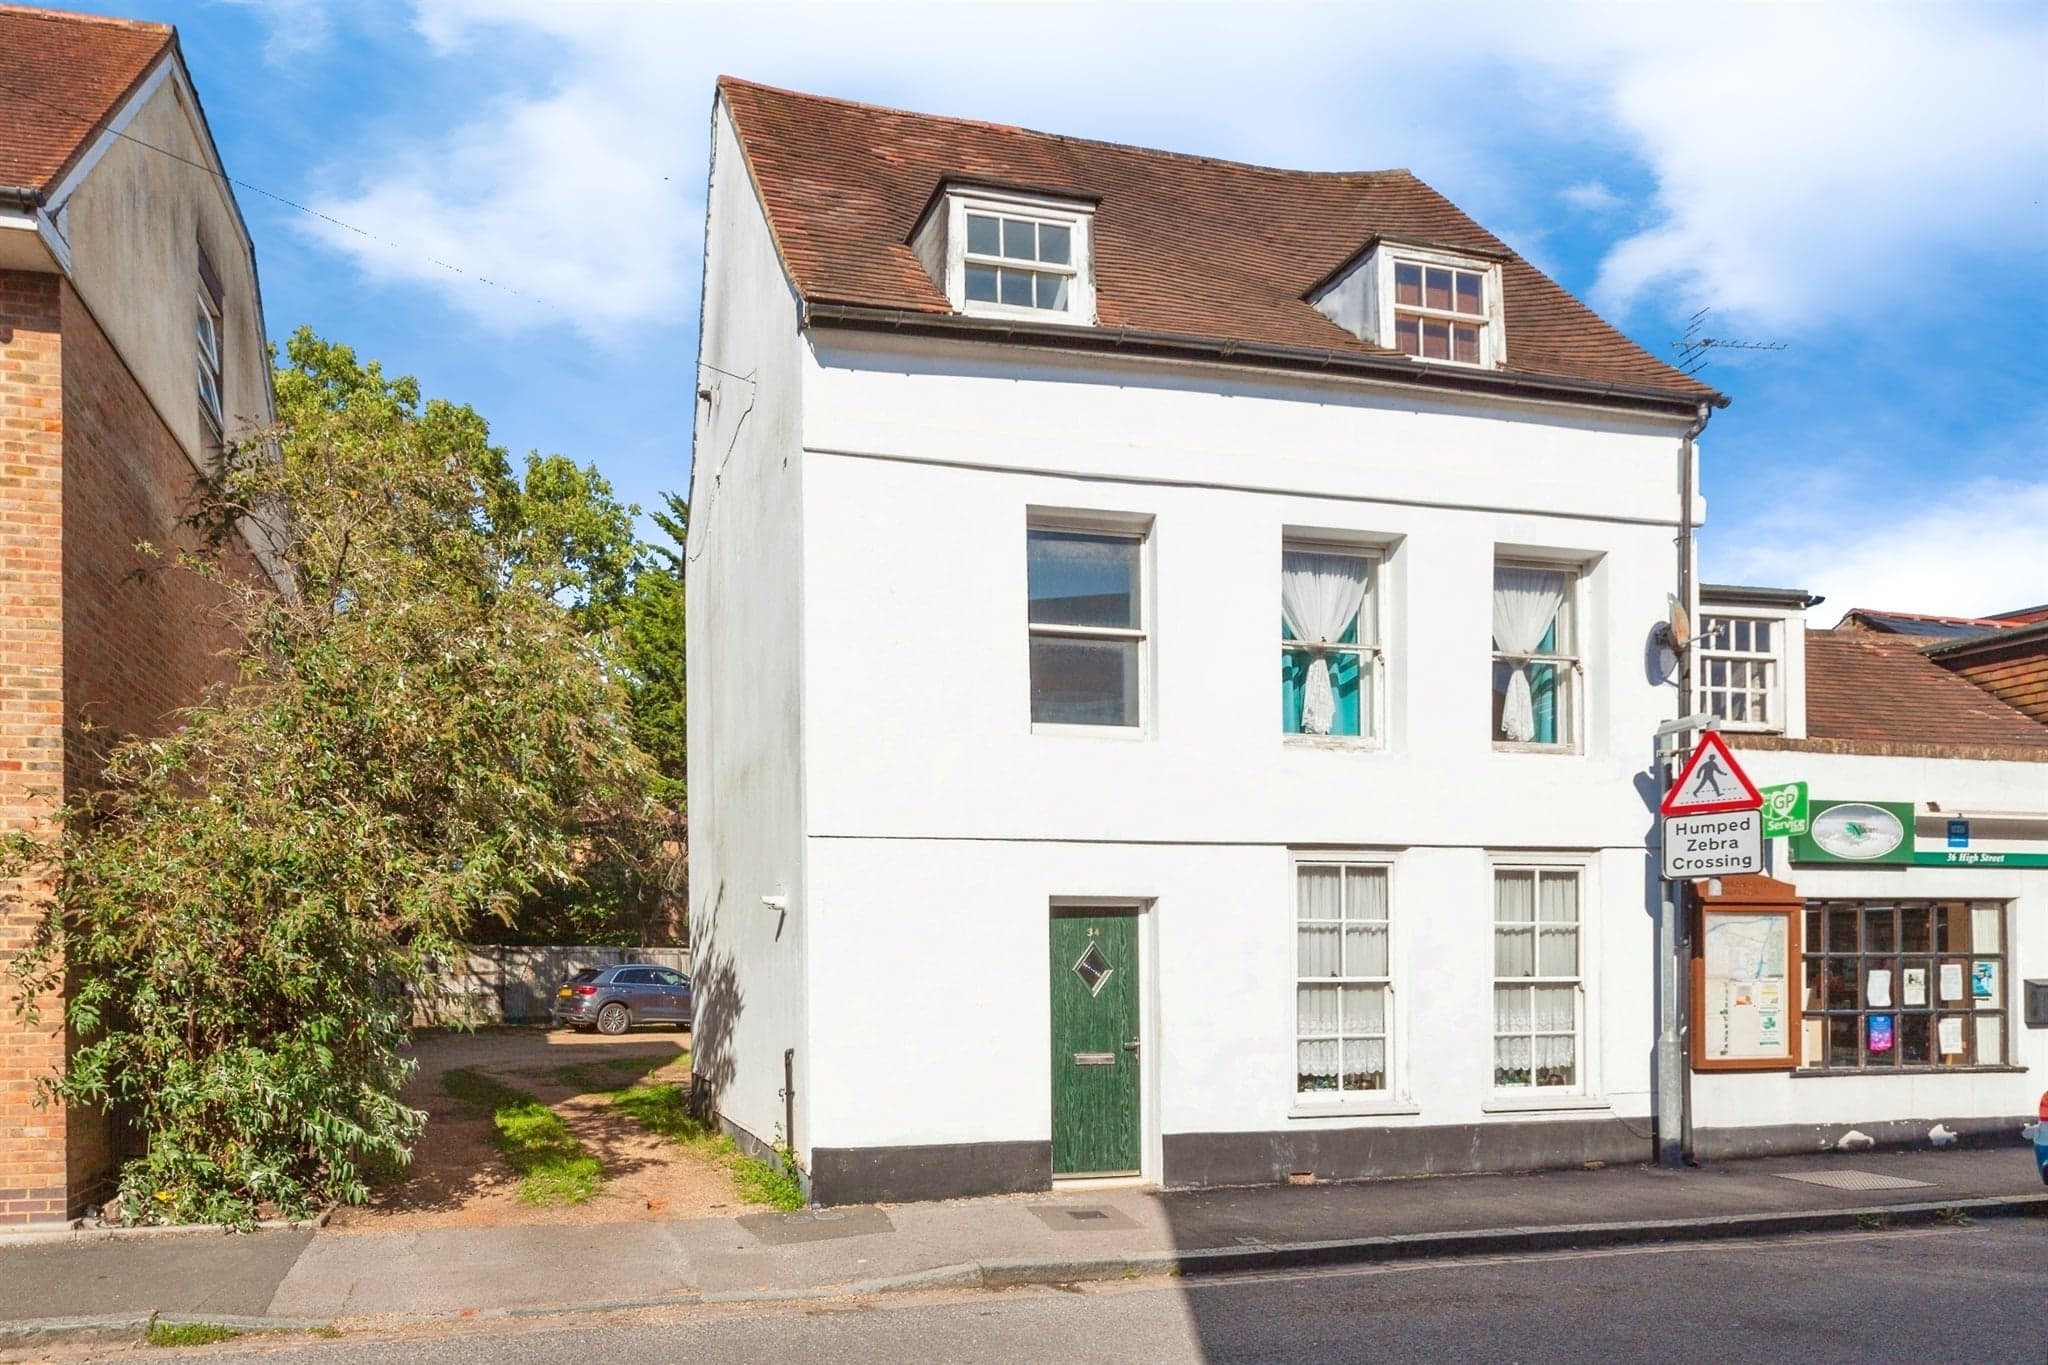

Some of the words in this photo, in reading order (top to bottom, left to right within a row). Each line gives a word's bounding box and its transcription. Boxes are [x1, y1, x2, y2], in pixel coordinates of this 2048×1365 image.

[1773, 793, 1796, 809] GP
[1676, 817, 1750, 836] Humped
[1767, 819, 1805, 831] Service
[1687, 837, 1739, 852] Zebra
[1672, 854, 1752, 869] Crossing
[1947, 852, 1957, 862] 36
[1959, 852, 1979, 864] High
[1980, 853, 2005, 862] Street
[1087, 928, 1100, 936] 34
